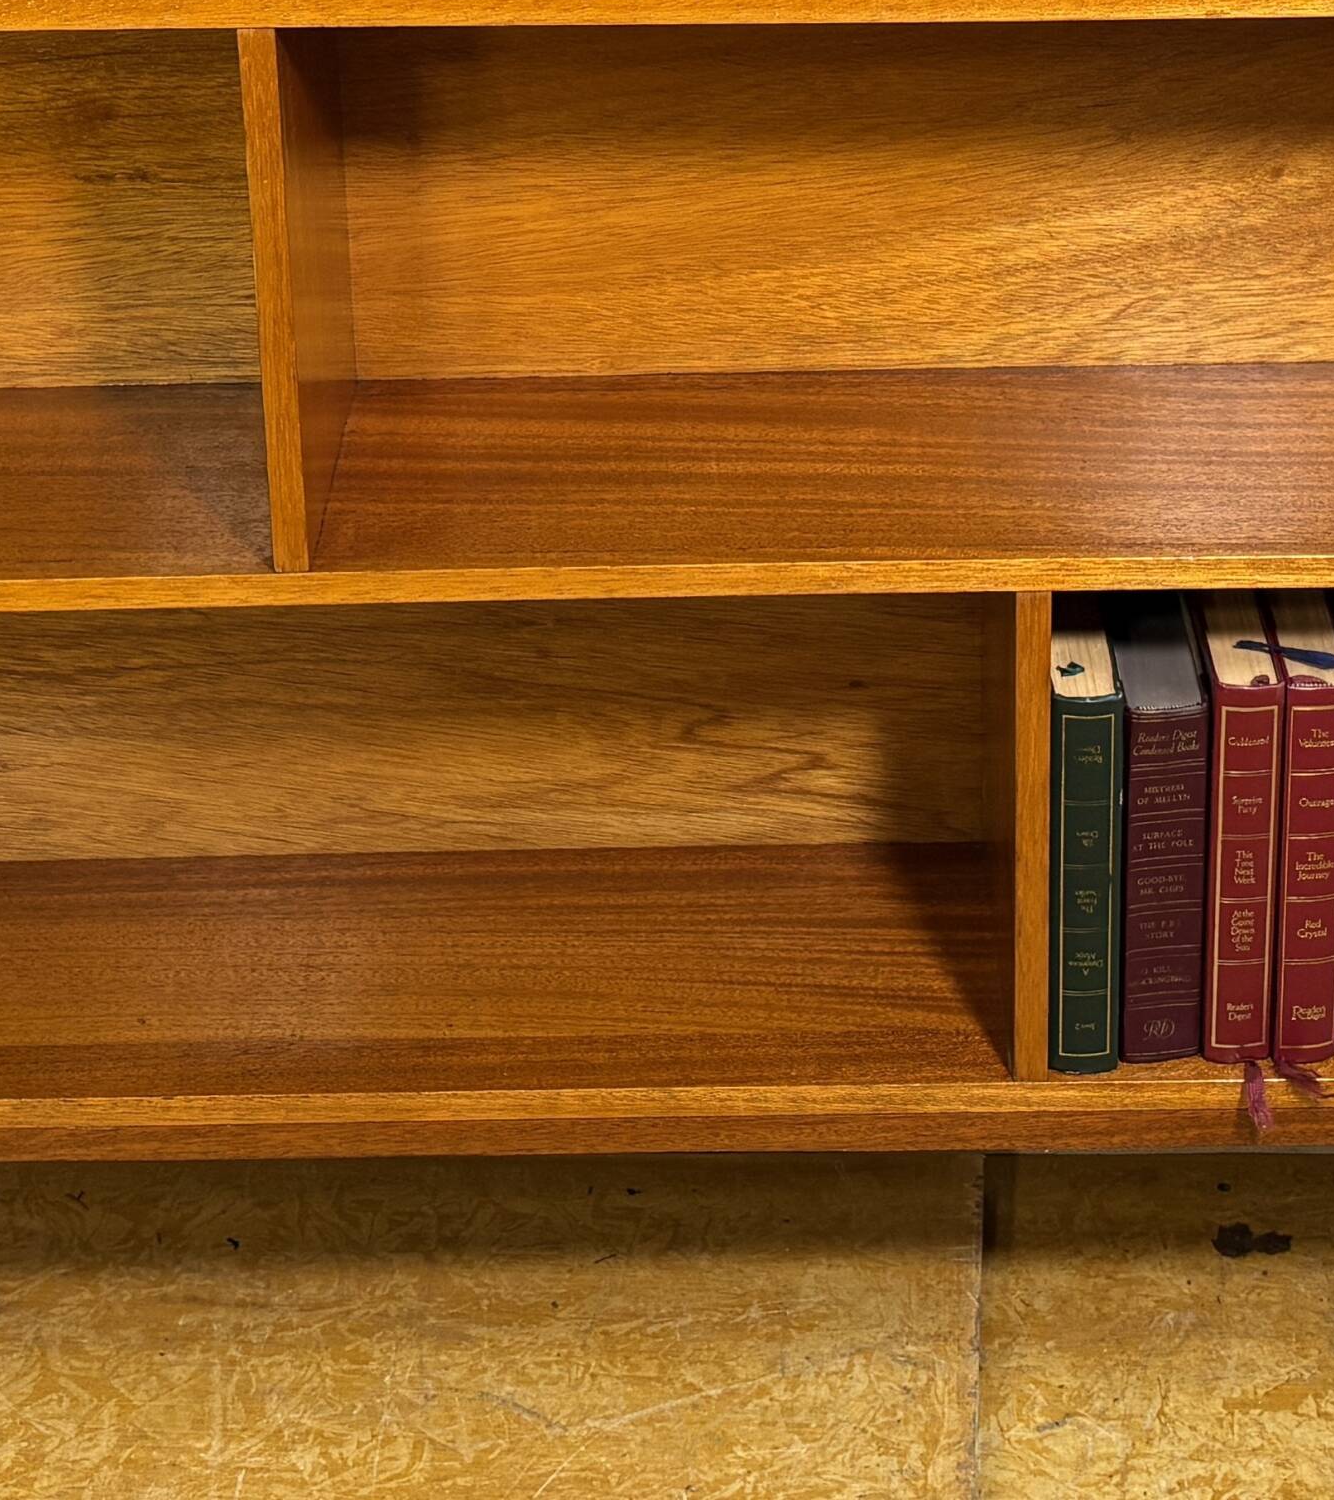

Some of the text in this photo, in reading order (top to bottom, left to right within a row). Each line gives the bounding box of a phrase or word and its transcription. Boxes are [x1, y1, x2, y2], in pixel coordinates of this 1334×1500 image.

[1309, 728, 1329, 738] The
[1297, 797, 1334, 809] Outrage
[1149, 841, 1167, 849] THE
[1234, 849, 1253, 859] This
[1304, 850, 1325, 861] The
[1234, 859, 1255, 868] Time
[1294, 860, 1334, 872] Incredible
[1233, 867, 1254, 877] Next
[1296, 869, 1331, 881] Journey
[1233, 876, 1256, 885] Week
[1304, 918, 1322, 929] Red
[1296, 927, 1327, 940] Crystal
